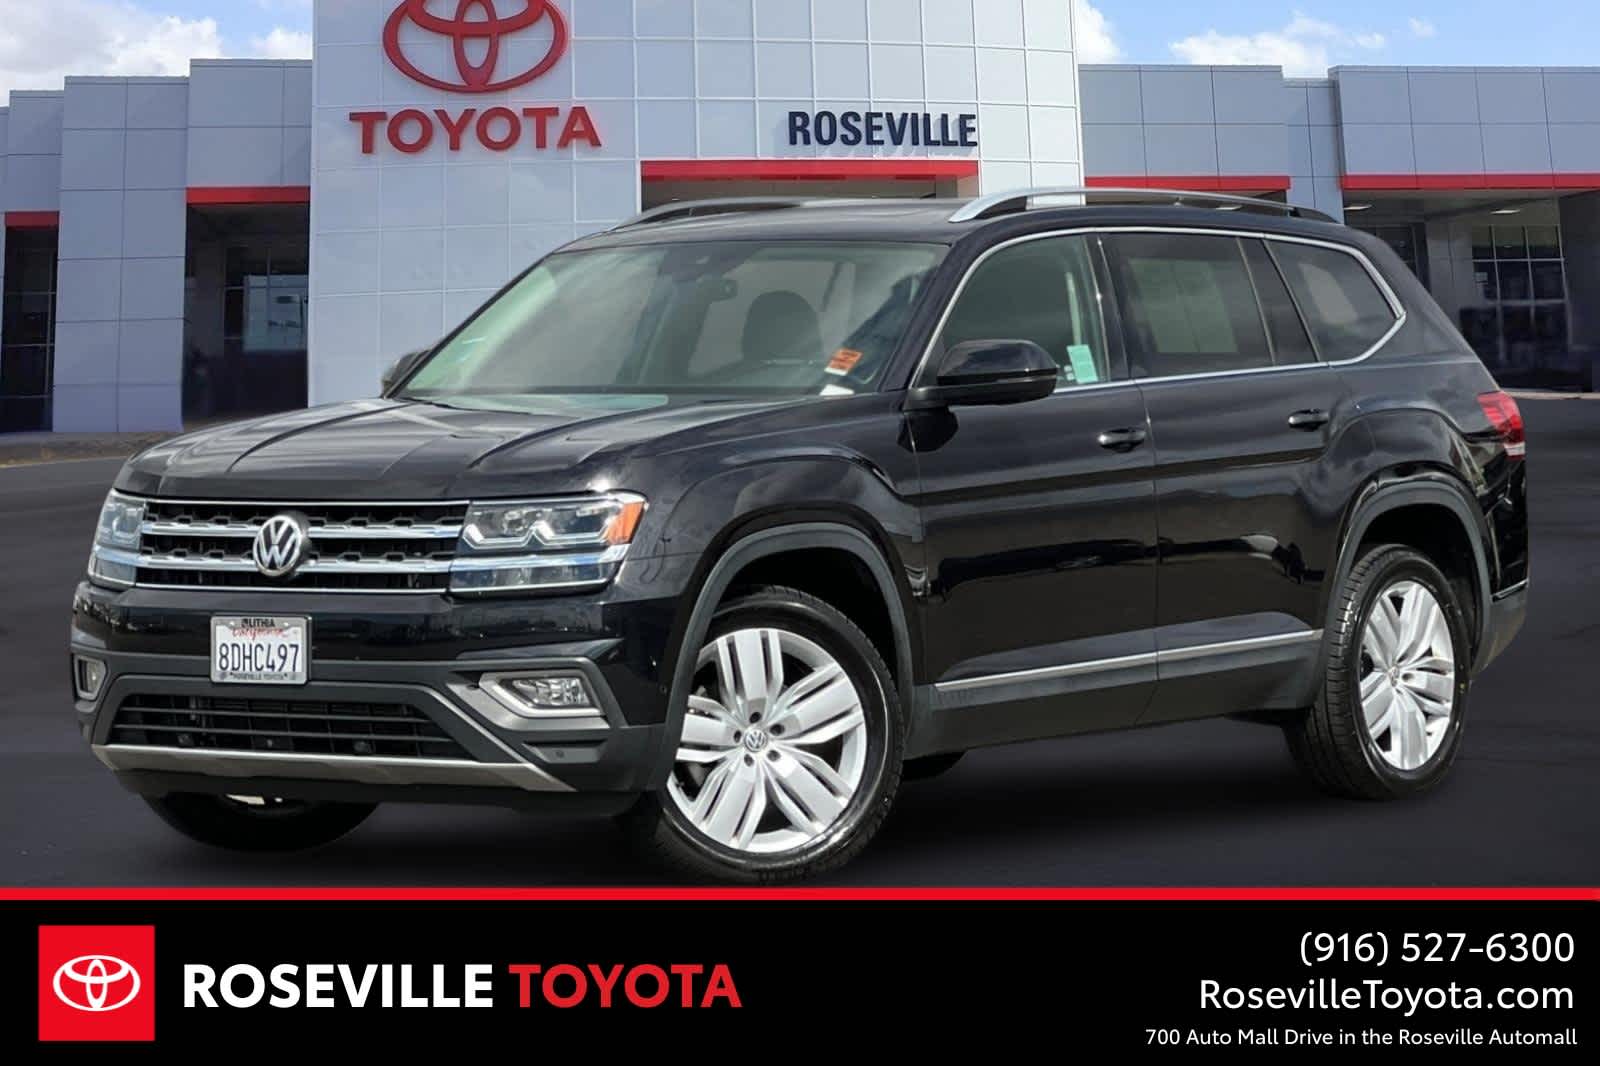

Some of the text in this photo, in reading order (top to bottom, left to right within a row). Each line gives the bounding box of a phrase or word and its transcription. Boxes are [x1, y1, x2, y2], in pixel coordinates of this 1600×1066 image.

[350, 106, 602, 153] TOYOTA
[788, 110, 978, 148] ROSEVILLE
[219, 642, 300, 672] 8DHC497
